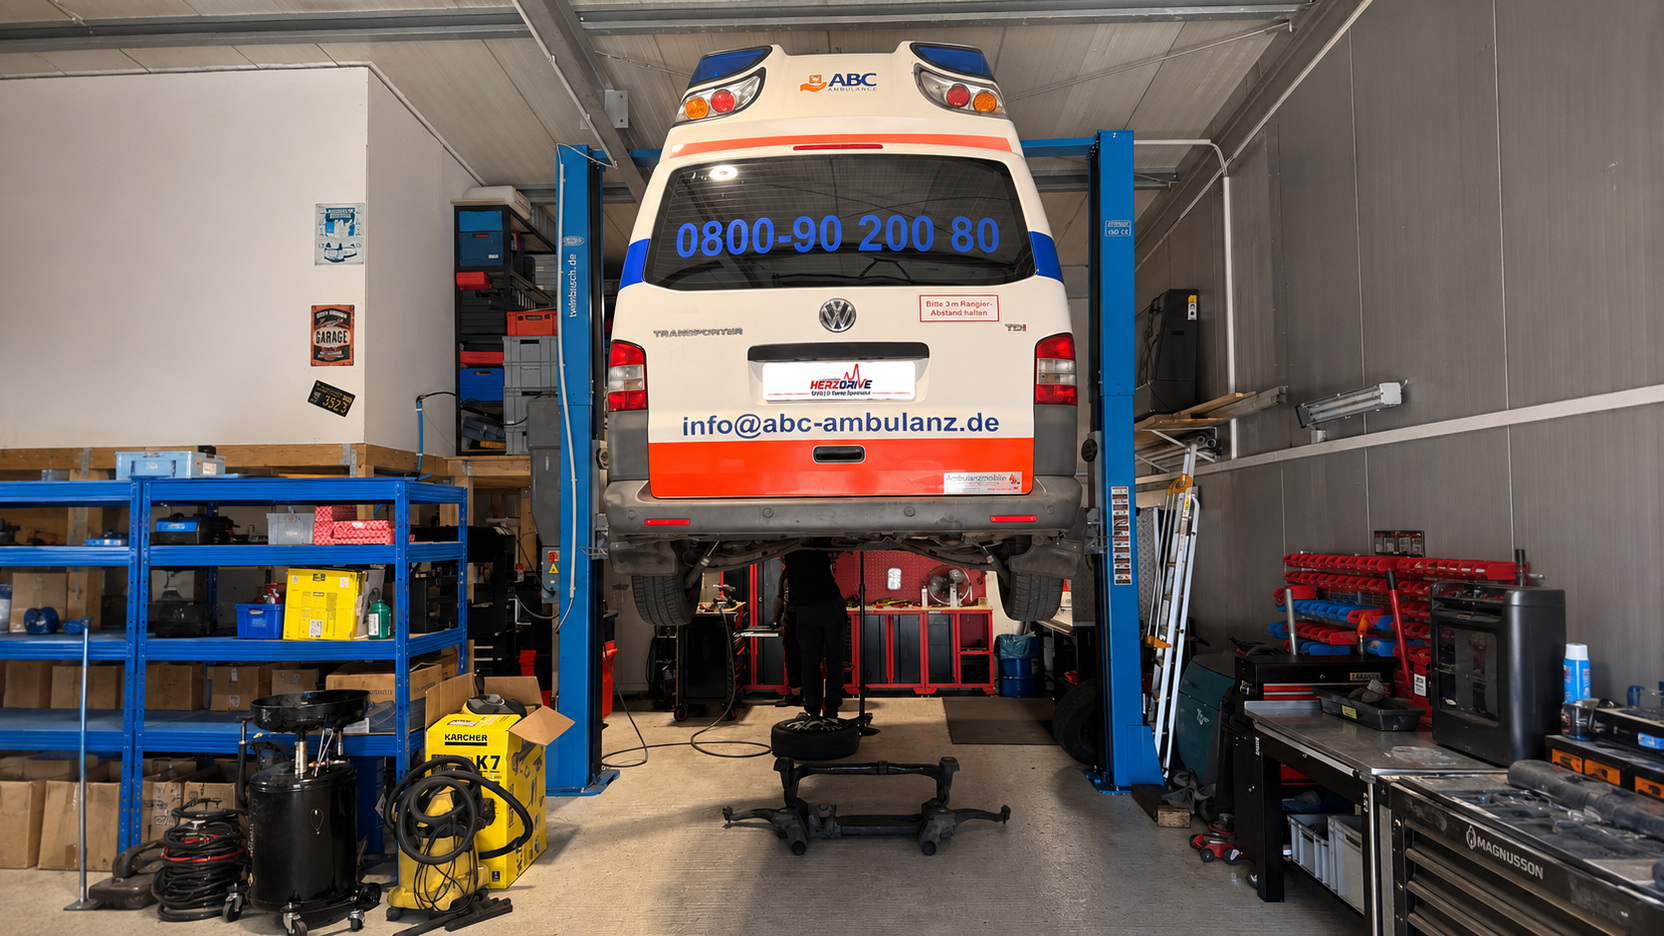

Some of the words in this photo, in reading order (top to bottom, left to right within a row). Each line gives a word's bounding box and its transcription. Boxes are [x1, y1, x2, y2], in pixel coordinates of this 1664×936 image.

[828, 73, 877, 87] ABC
[676, 214, 842, 258] 0800-90
[858, 214, 935, 252] 200
[951, 216, 1000, 253] 80
[930, 309, 962, 317] Abstand
[964, 309, 988, 317] halten
[316, 330, 348, 344] GARAGE
[653, 327, 743, 338] TRANSPORTER
[810, 378, 873, 390] HERZDRIVE
[322, 395, 348, 414] 3523
[682, 412, 1000, 439] info@abc-ambulanz.de
[1477, 836, 1544, 880] MAGNUSSON
